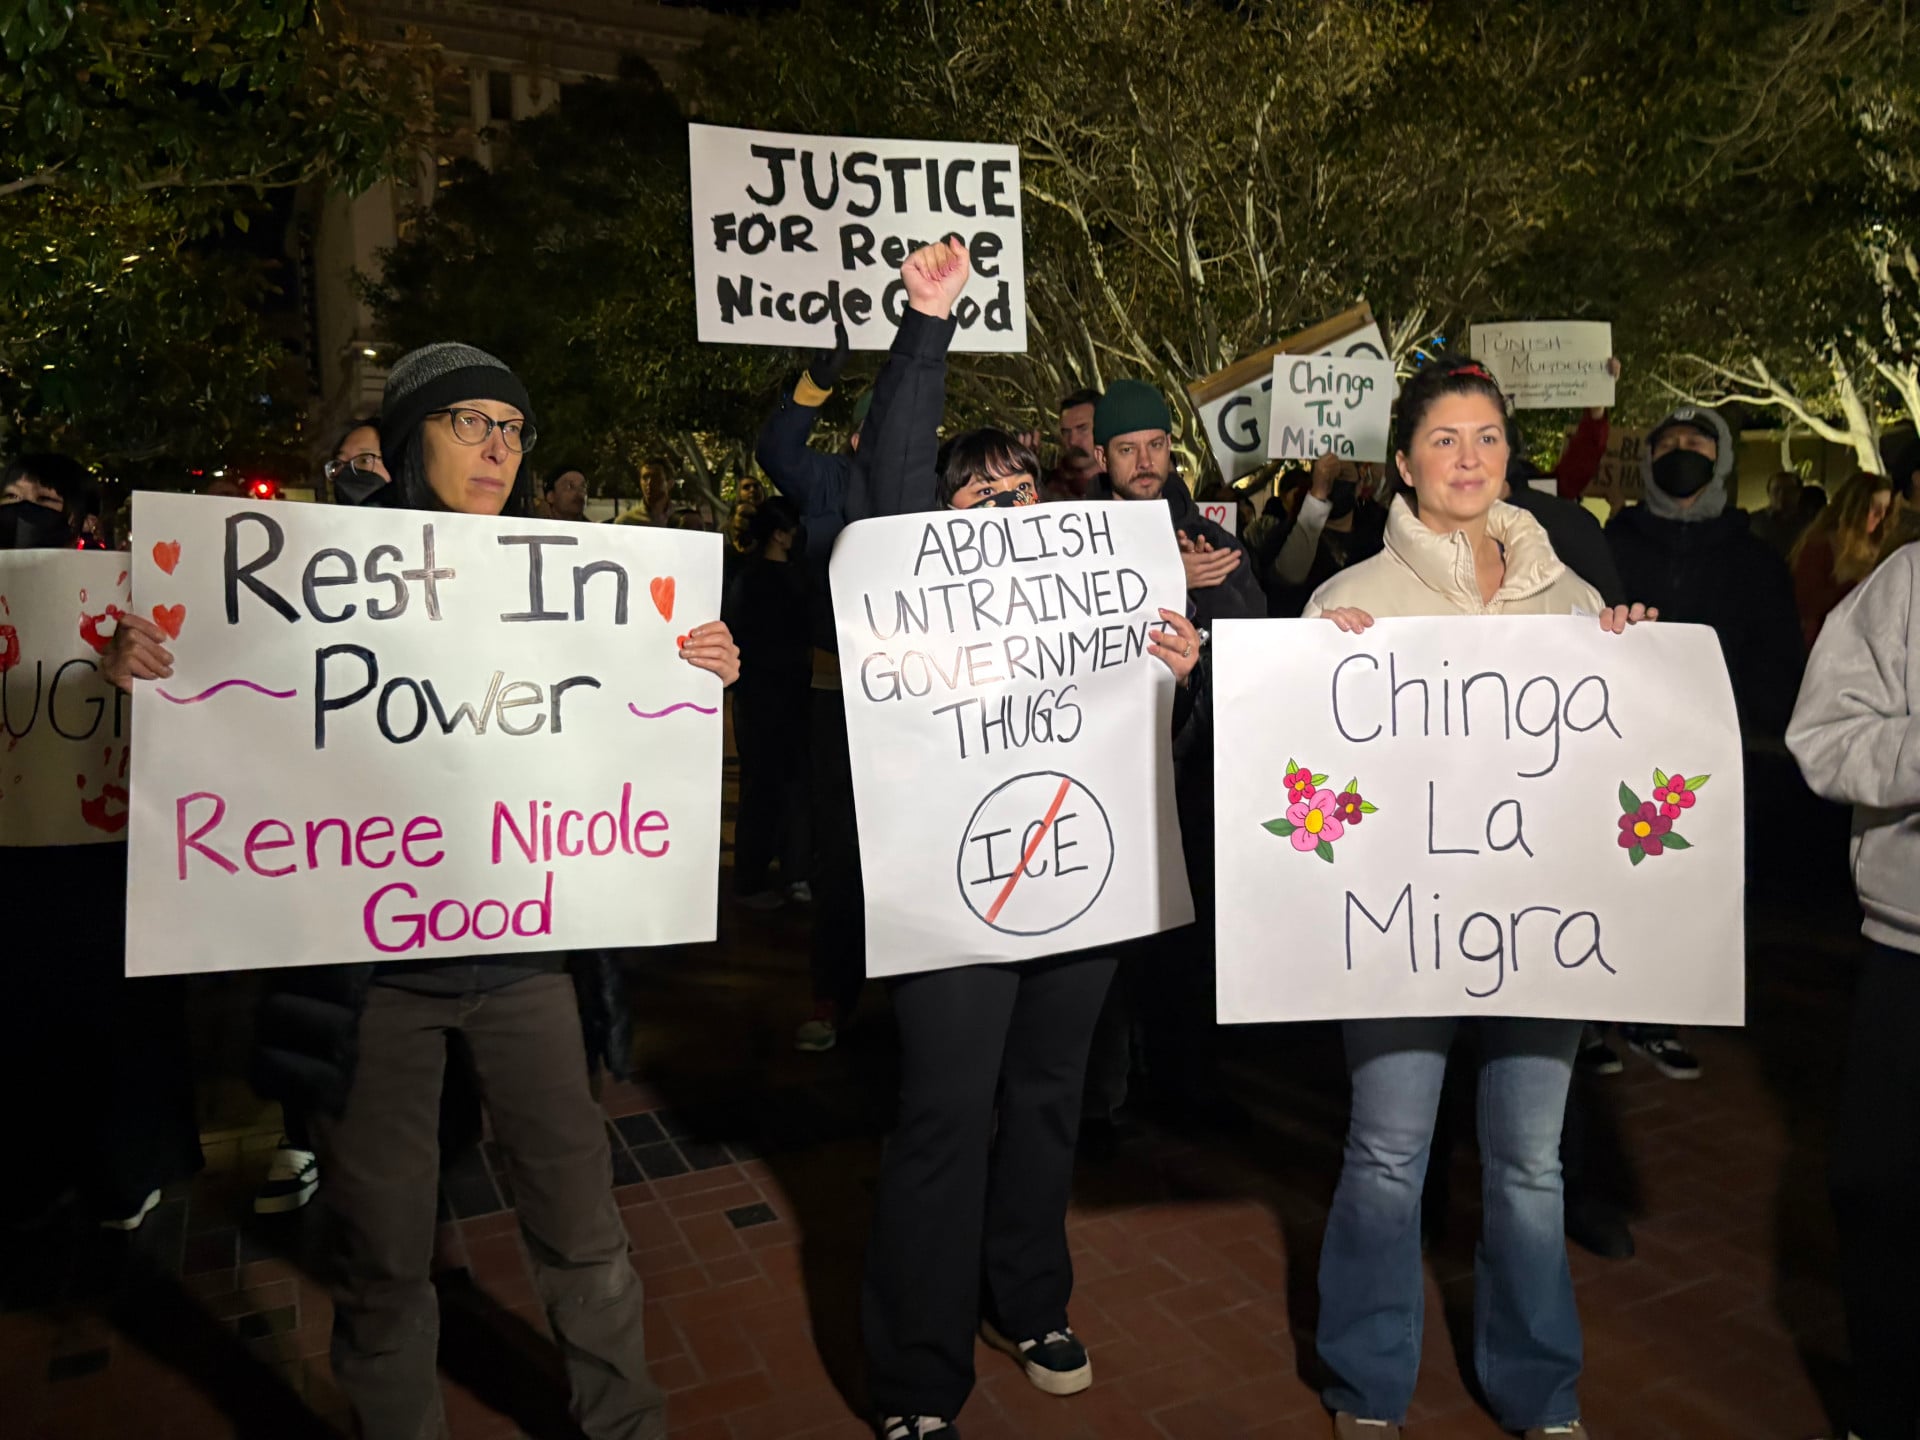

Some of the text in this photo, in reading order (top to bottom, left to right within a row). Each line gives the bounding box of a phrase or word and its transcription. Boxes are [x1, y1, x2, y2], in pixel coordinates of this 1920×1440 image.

[745, 143, 1016, 218] JUSTICE
[710, 212, 1003, 278] FOR Ree
[716, 274, 1013, 332] Nicole God
[1289, 360, 1374, 409] Chinga
[1304, 400, 1342, 428] Tu
[1281, 425, 1355, 458] Migra
[223, 511, 628, 626] Rest In
[913, 511, 1115, 577] ABOLISH
[864, 567, 1148, 641] UNTRAINED
[314, 643, 602, 750] Power
[932, 684, 1082, 759] THUGS
[1331, 651, 1623, 778] Chinga
[176, 781, 670, 880] Renee Nicole
[970, 812, 1089, 887] ICE
[1427, 780, 1534, 858] La
[363, 871, 554, 953] Good
[1344, 882, 1618, 998] Migra
